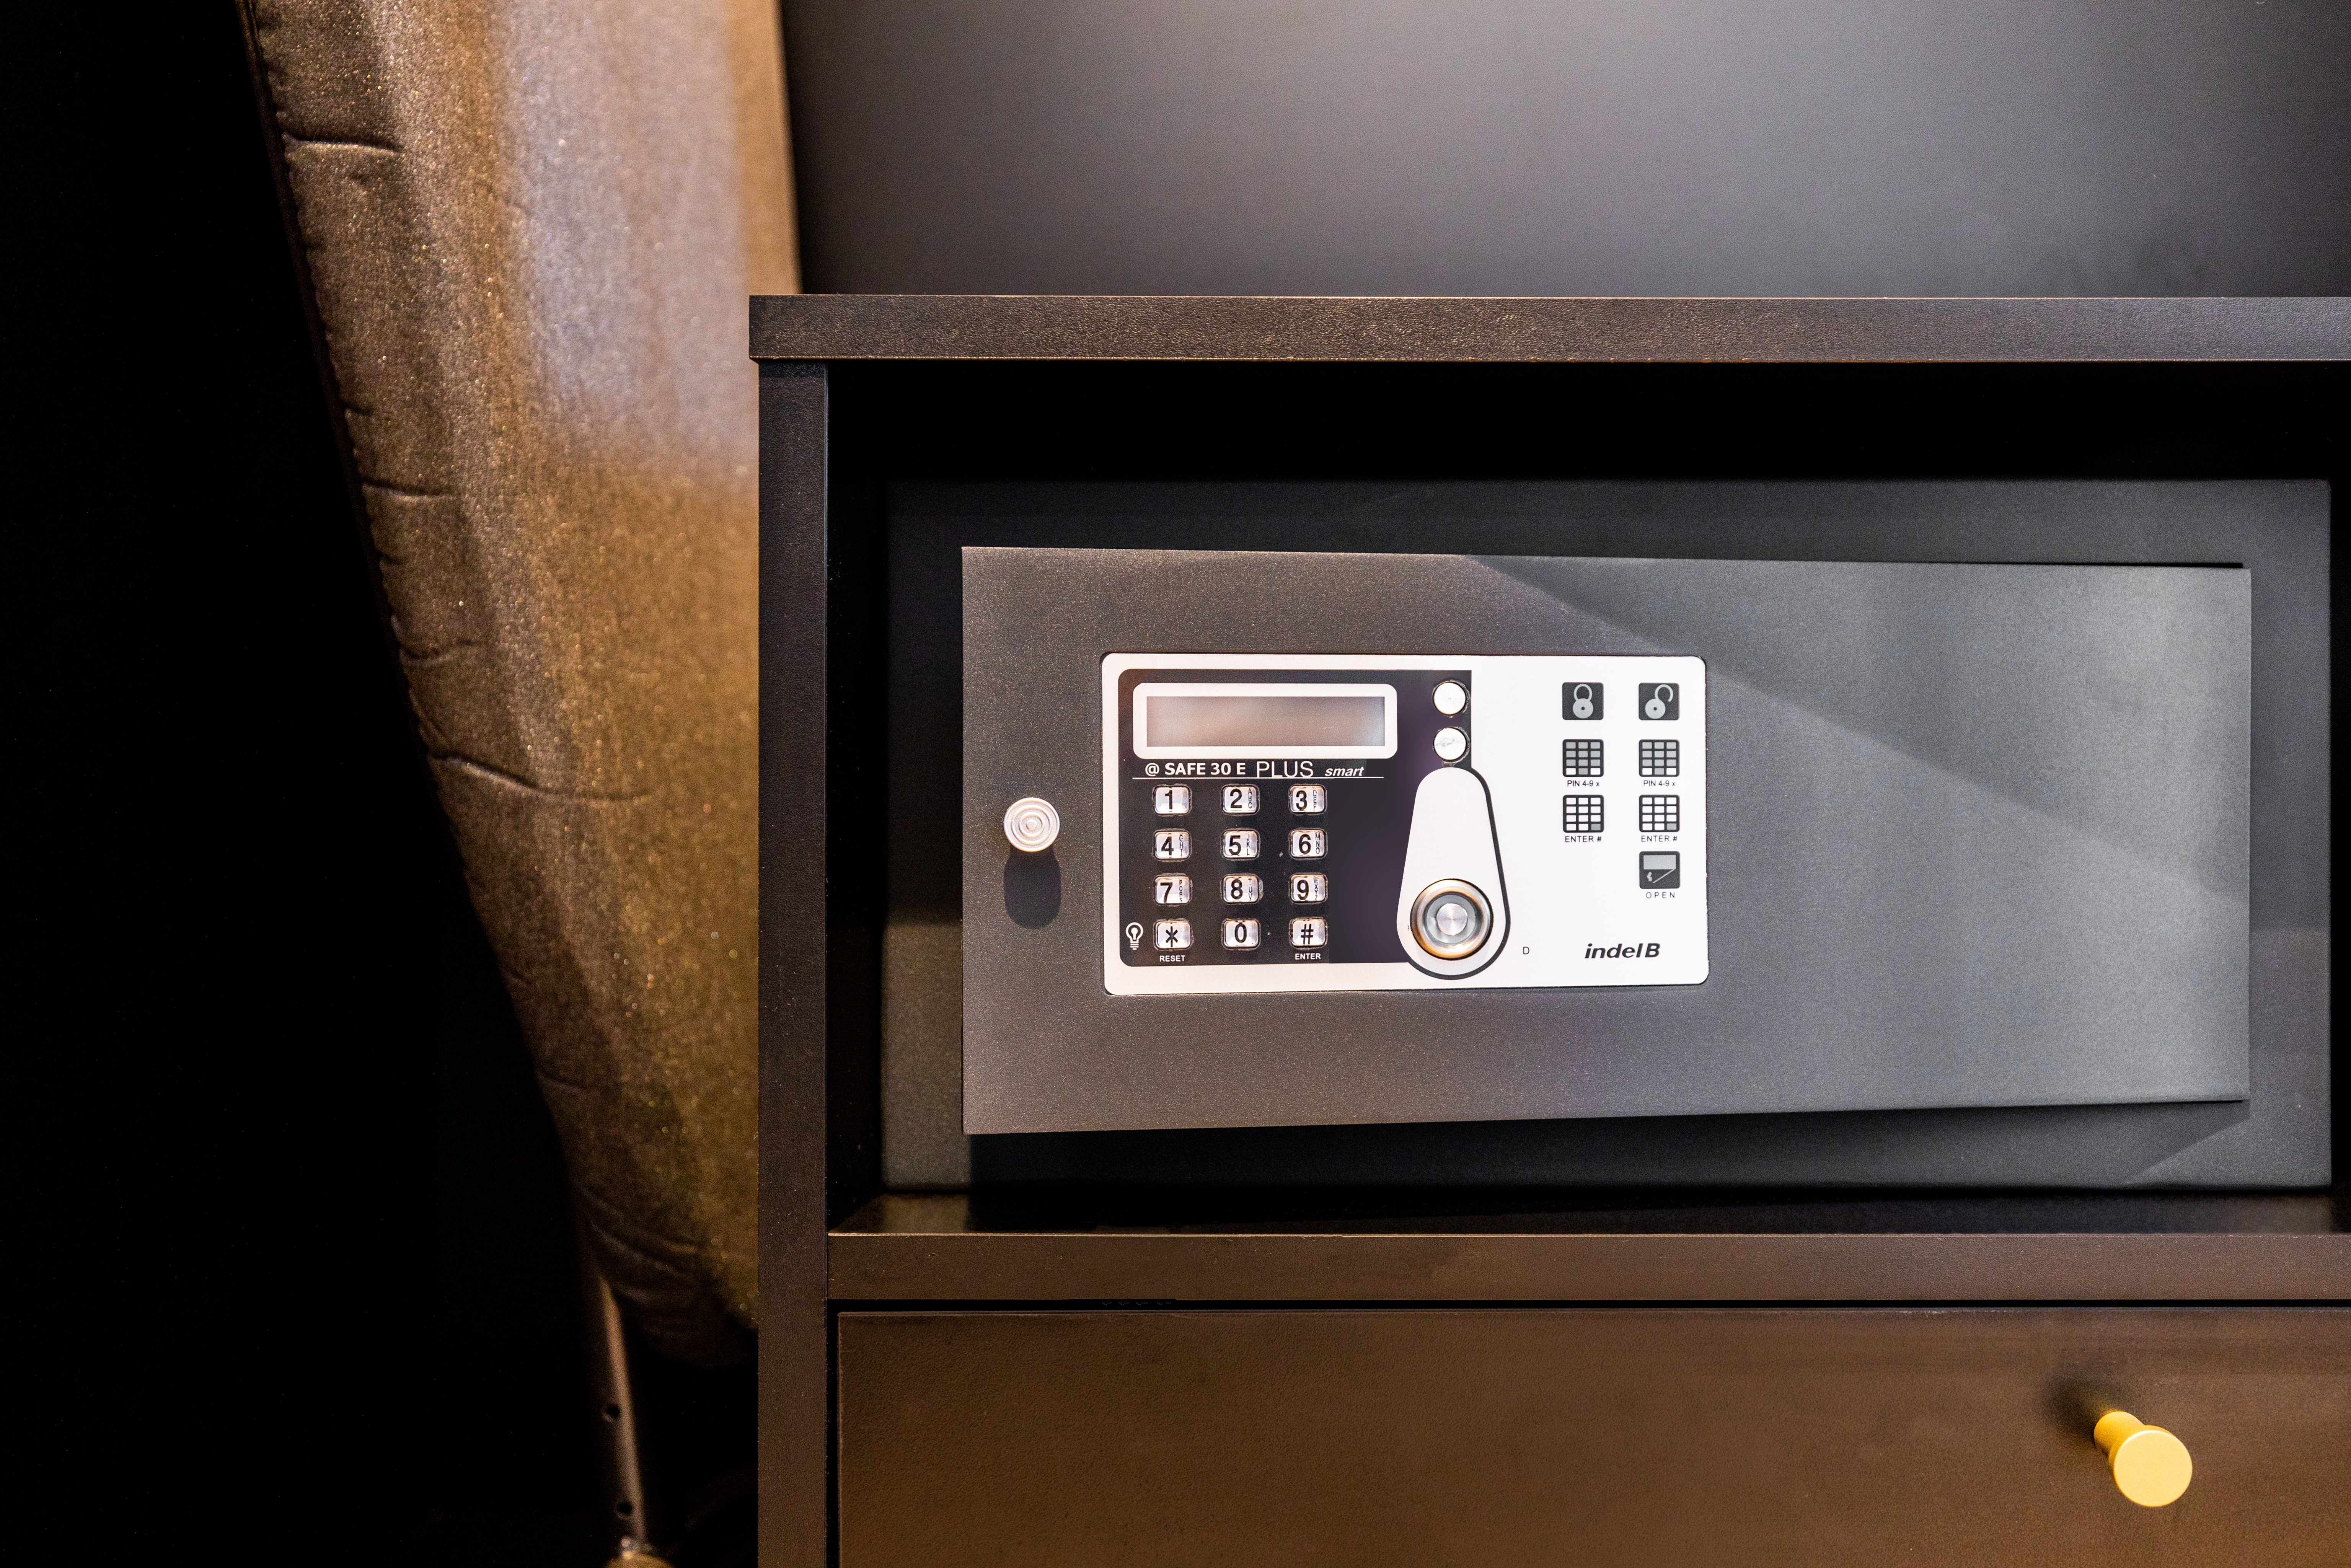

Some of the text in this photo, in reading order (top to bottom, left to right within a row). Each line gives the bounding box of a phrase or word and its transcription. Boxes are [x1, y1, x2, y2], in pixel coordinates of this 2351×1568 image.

[1165, 763, 1206, 775] SAFE
[1211, 763, 1231, 775] 30
[1236, 763, 1246, 775] E
[1256, 761, 1314, 777] PLUS
[1324, 766, 1365, 776] smart
[1165, 790, 1173, 810] 1
[1230, 789, 1242, 808] 2
[1296, 790, 1308, 811] 3
[1161, 836, 1174, 856] 4
[1228, 835, 1242, 856] 5
[1298, 833, 1311, 854] 6
[1160, 882, 1173, 903] 7
[1230, 879, 1243, 900] 8
[1296, 879, 1309, 900] 9
[1234, 923, 1247, 943] 0
[1301, 923, 1314, 945] #
[1523, 946, 1530, 955] D
